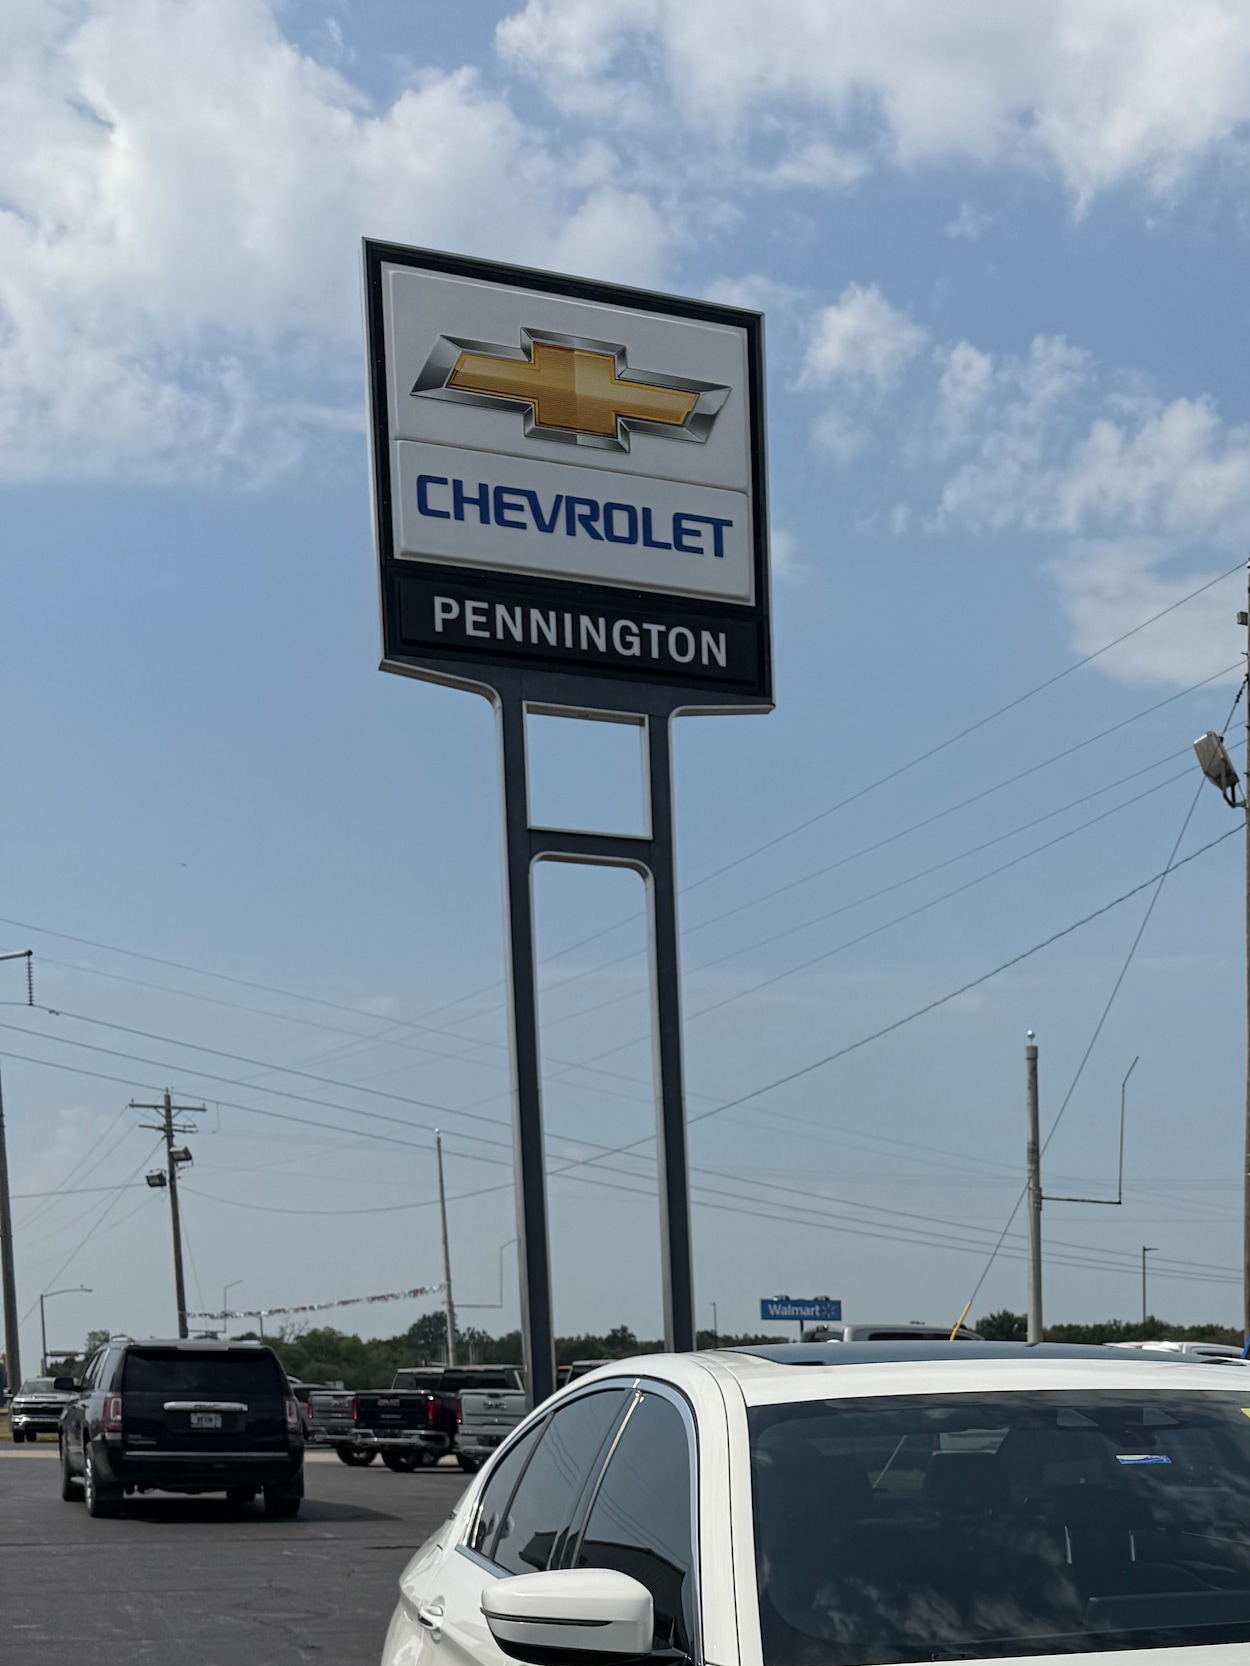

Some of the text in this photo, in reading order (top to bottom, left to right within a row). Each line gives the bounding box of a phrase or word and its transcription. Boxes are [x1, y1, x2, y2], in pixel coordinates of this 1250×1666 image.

[416, 474, 733, 558] CHEVROLET
[433, 595, 727, 667] PENNINGTON
[767, 1303, 820, 1317] Walmart
